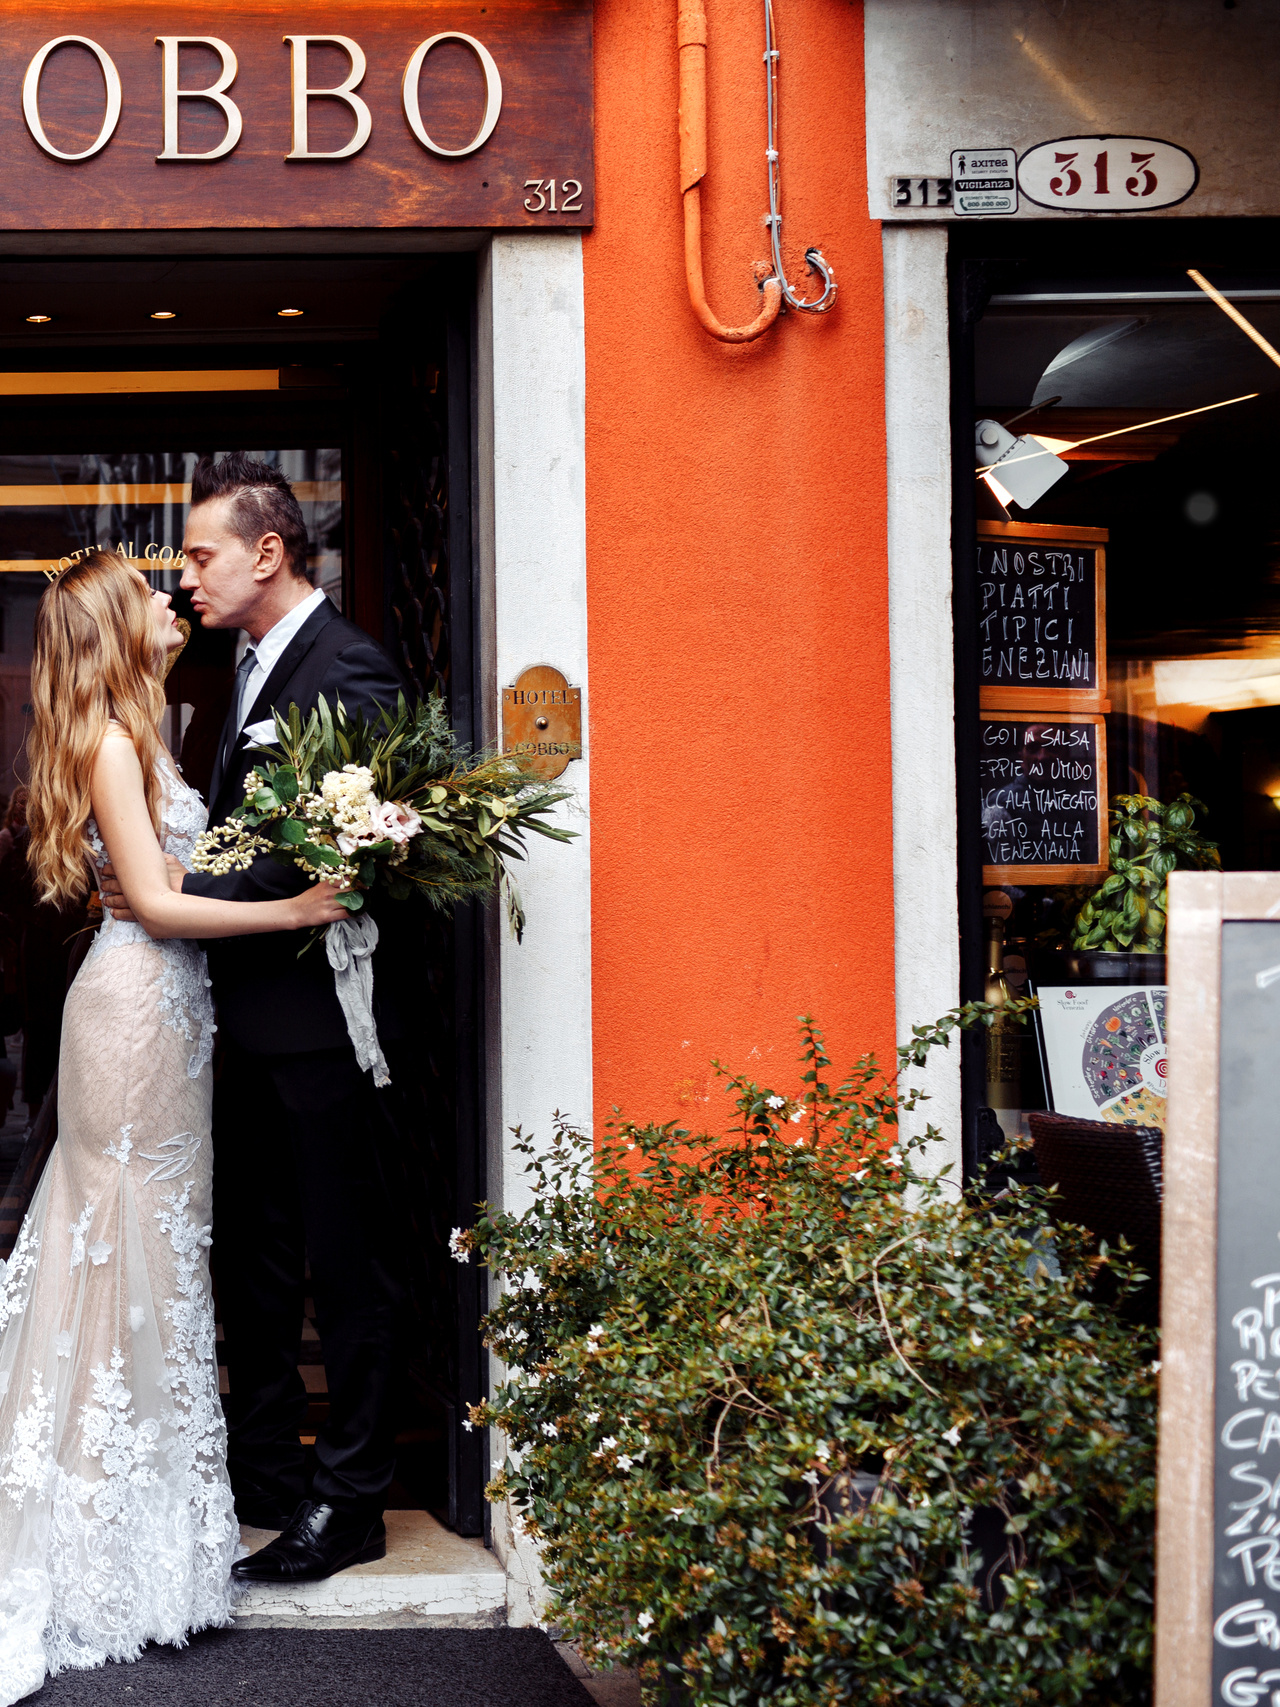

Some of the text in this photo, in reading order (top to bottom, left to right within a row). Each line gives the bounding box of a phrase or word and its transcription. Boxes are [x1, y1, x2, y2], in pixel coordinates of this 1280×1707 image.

[1049, 150, 1158, 197] 313
[523, 179, 583, 212] 312
[896, 178, 952, 205] 313
[116, 541, 138, 559] AL
[990, 549, 1084, 582] NOSTRI
[980, 582, 1070, 610] PIATTI
[980, 610, 1073, 644] TIPICI
[982, 646, 1090, 682] ENEZIANI
[513, 690, 573, 705] HOTEL
[1024, 731, 1035, 746] IN
[1040, 728, 1090, 751] SALSA
[1029, 763, 1044, 776] IN
[1051, 758, 1092, 780] UMIDO
[1041, 819, 1085, 840] ALLA
[987, 839, 1081, 863] VENEXIANA
